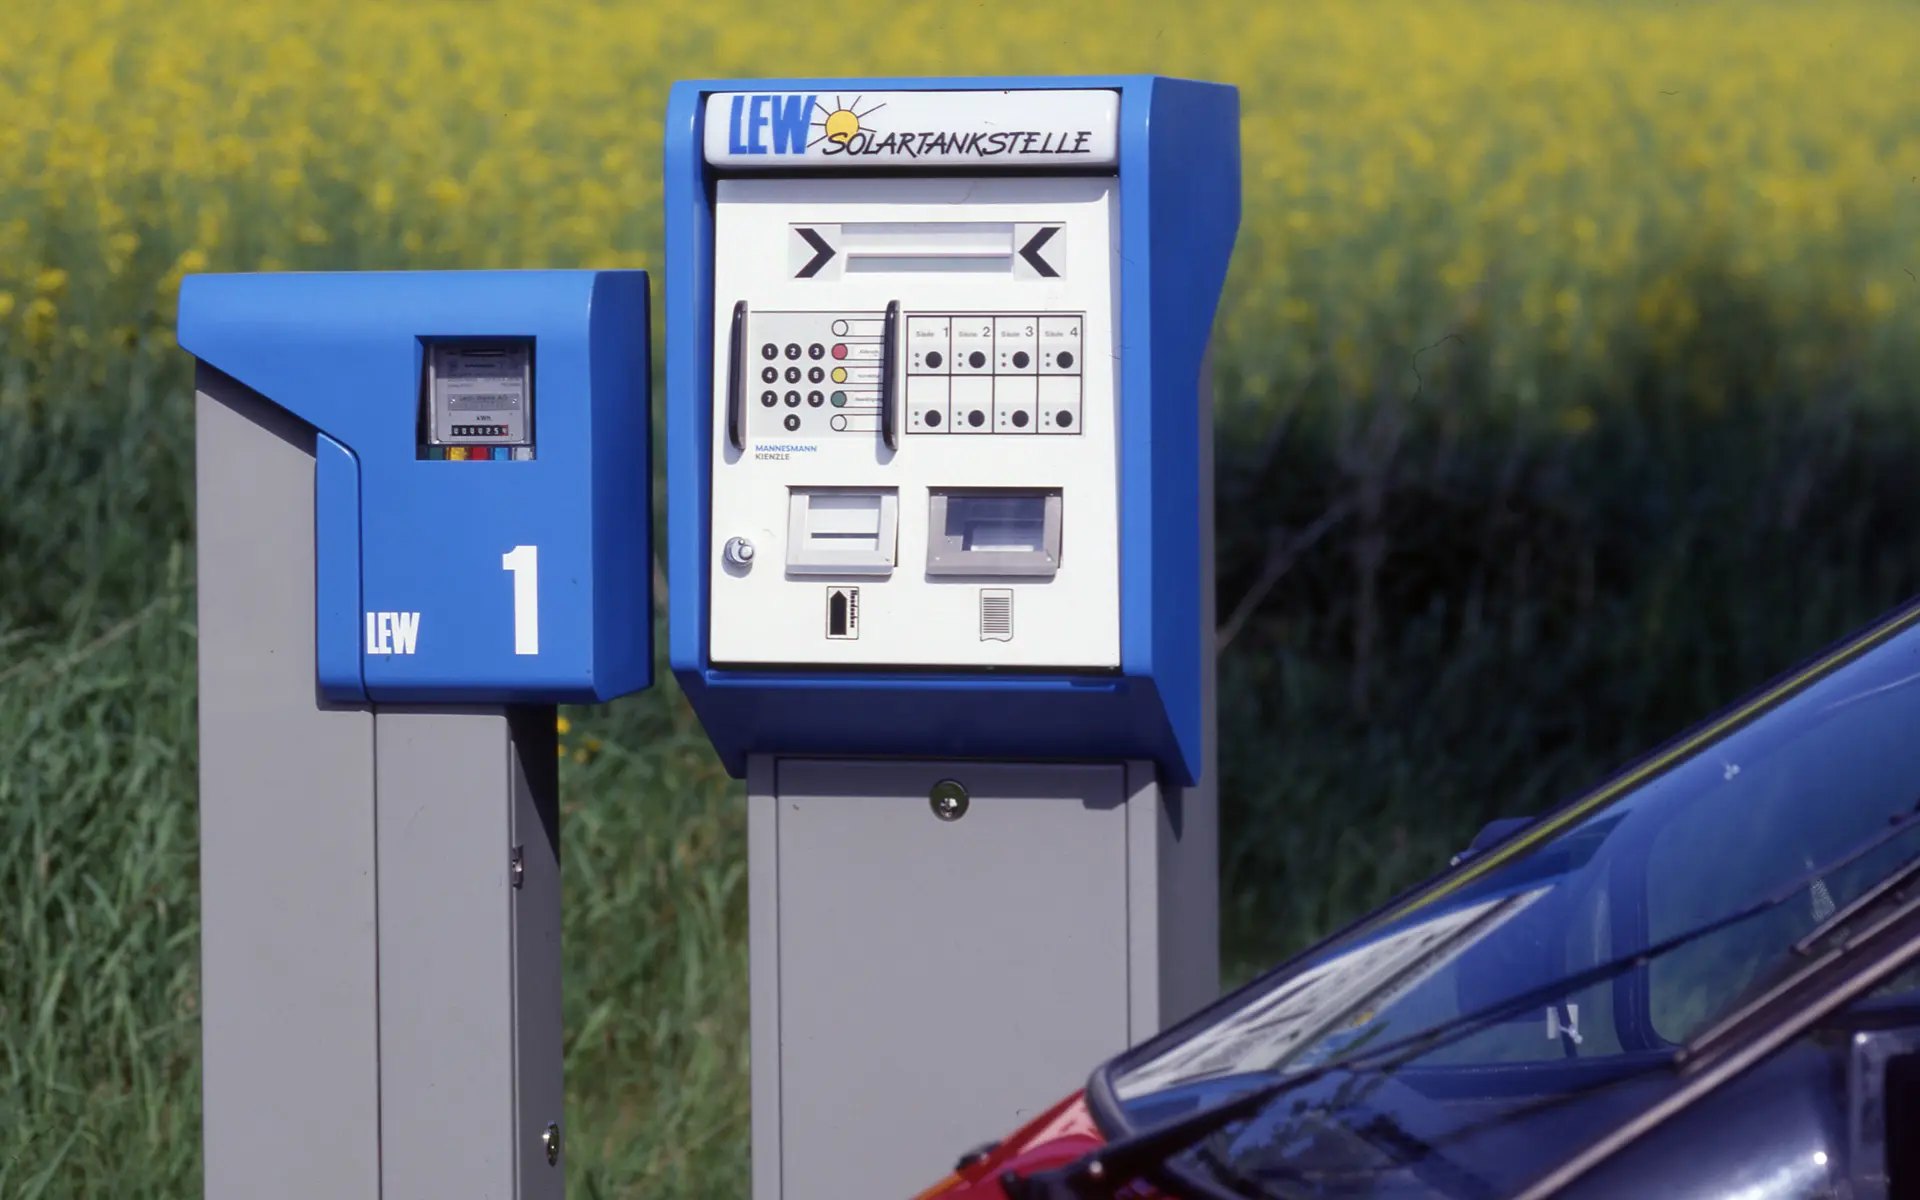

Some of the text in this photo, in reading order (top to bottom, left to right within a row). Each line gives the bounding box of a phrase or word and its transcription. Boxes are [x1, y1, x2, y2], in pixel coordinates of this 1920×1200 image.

[729, 95, 1092, 158] LEW SOLARTANKSTELLE
[943, 327, 949, 338] 1
[982, 326, 991, 338] 2
[1025, 326, 1034, 338] 3
[1070, 326, 1078, 338] 4
[767, 347, 820, 356] 1 2 3
[766, 370, 819, 379] 4 5 6
[766, 394, 819, 403] 7 8 9
[789, 418, 795, 427] 0
[502, 545, 539, 655] 1
[366, 612, 420, 654] LEW
